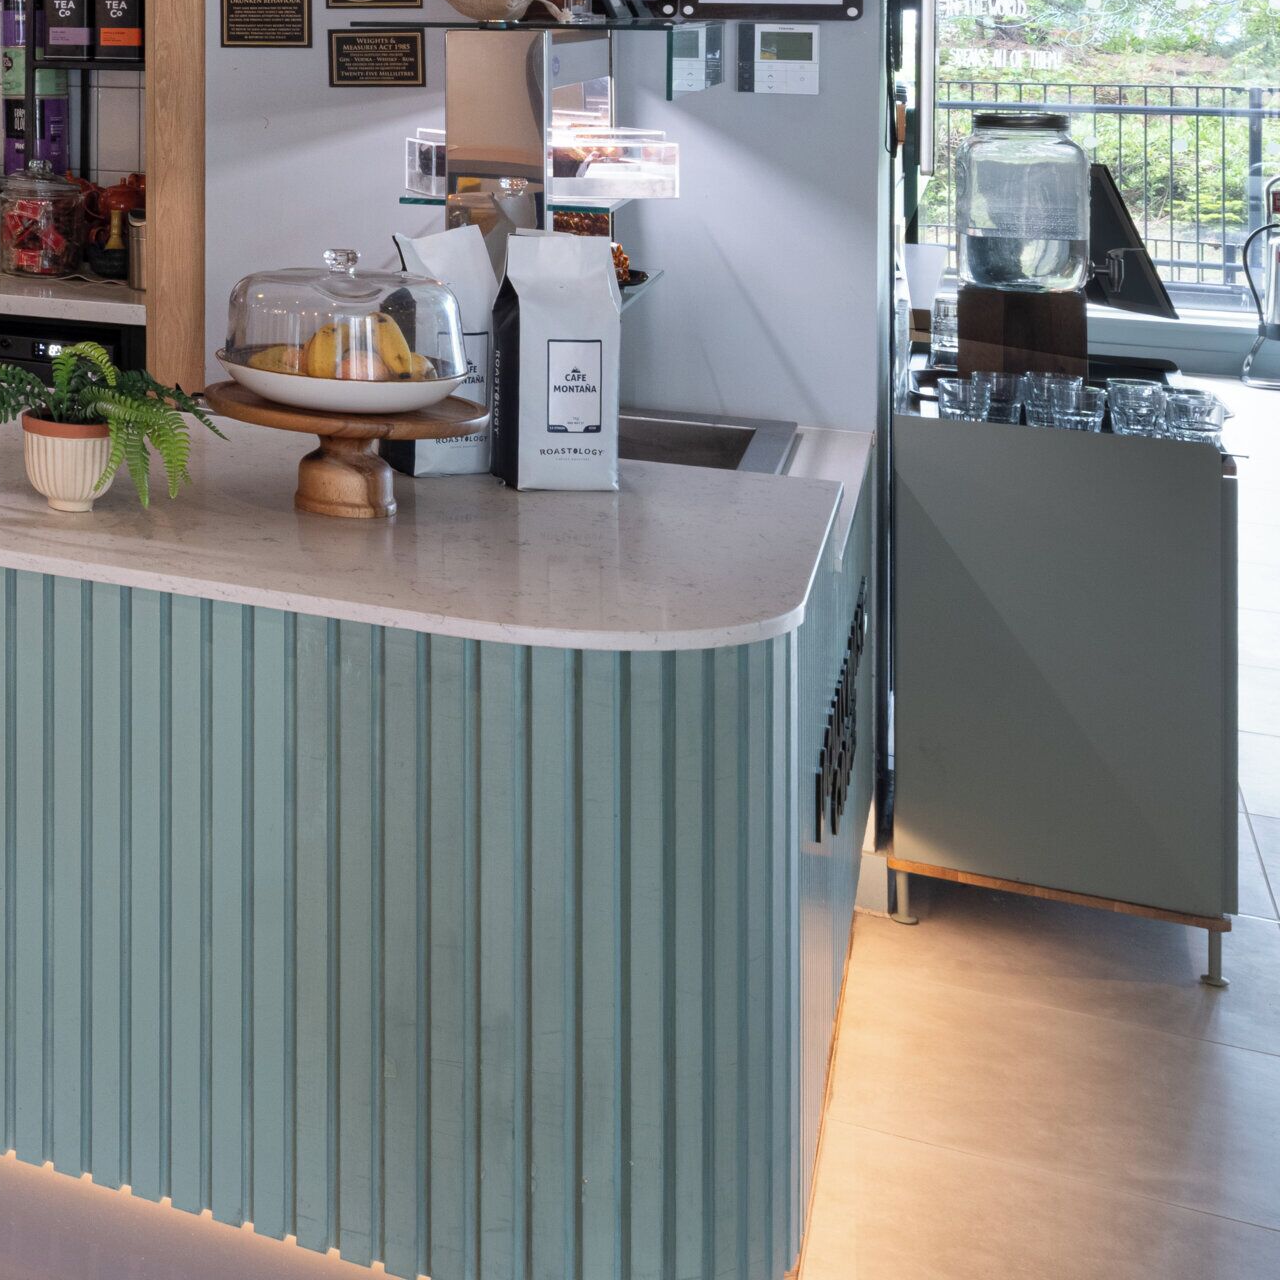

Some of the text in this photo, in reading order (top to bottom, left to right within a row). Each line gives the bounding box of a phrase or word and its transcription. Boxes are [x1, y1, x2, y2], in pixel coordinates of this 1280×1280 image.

[106, 1, 127, 9] TEA
[59, 9, 70, 17] Co
[110, 10, 122, 18] Co
[554, 384, 597, 393] MONTAÑA
[539, 448, 603, 456] ROASTOLOGY
